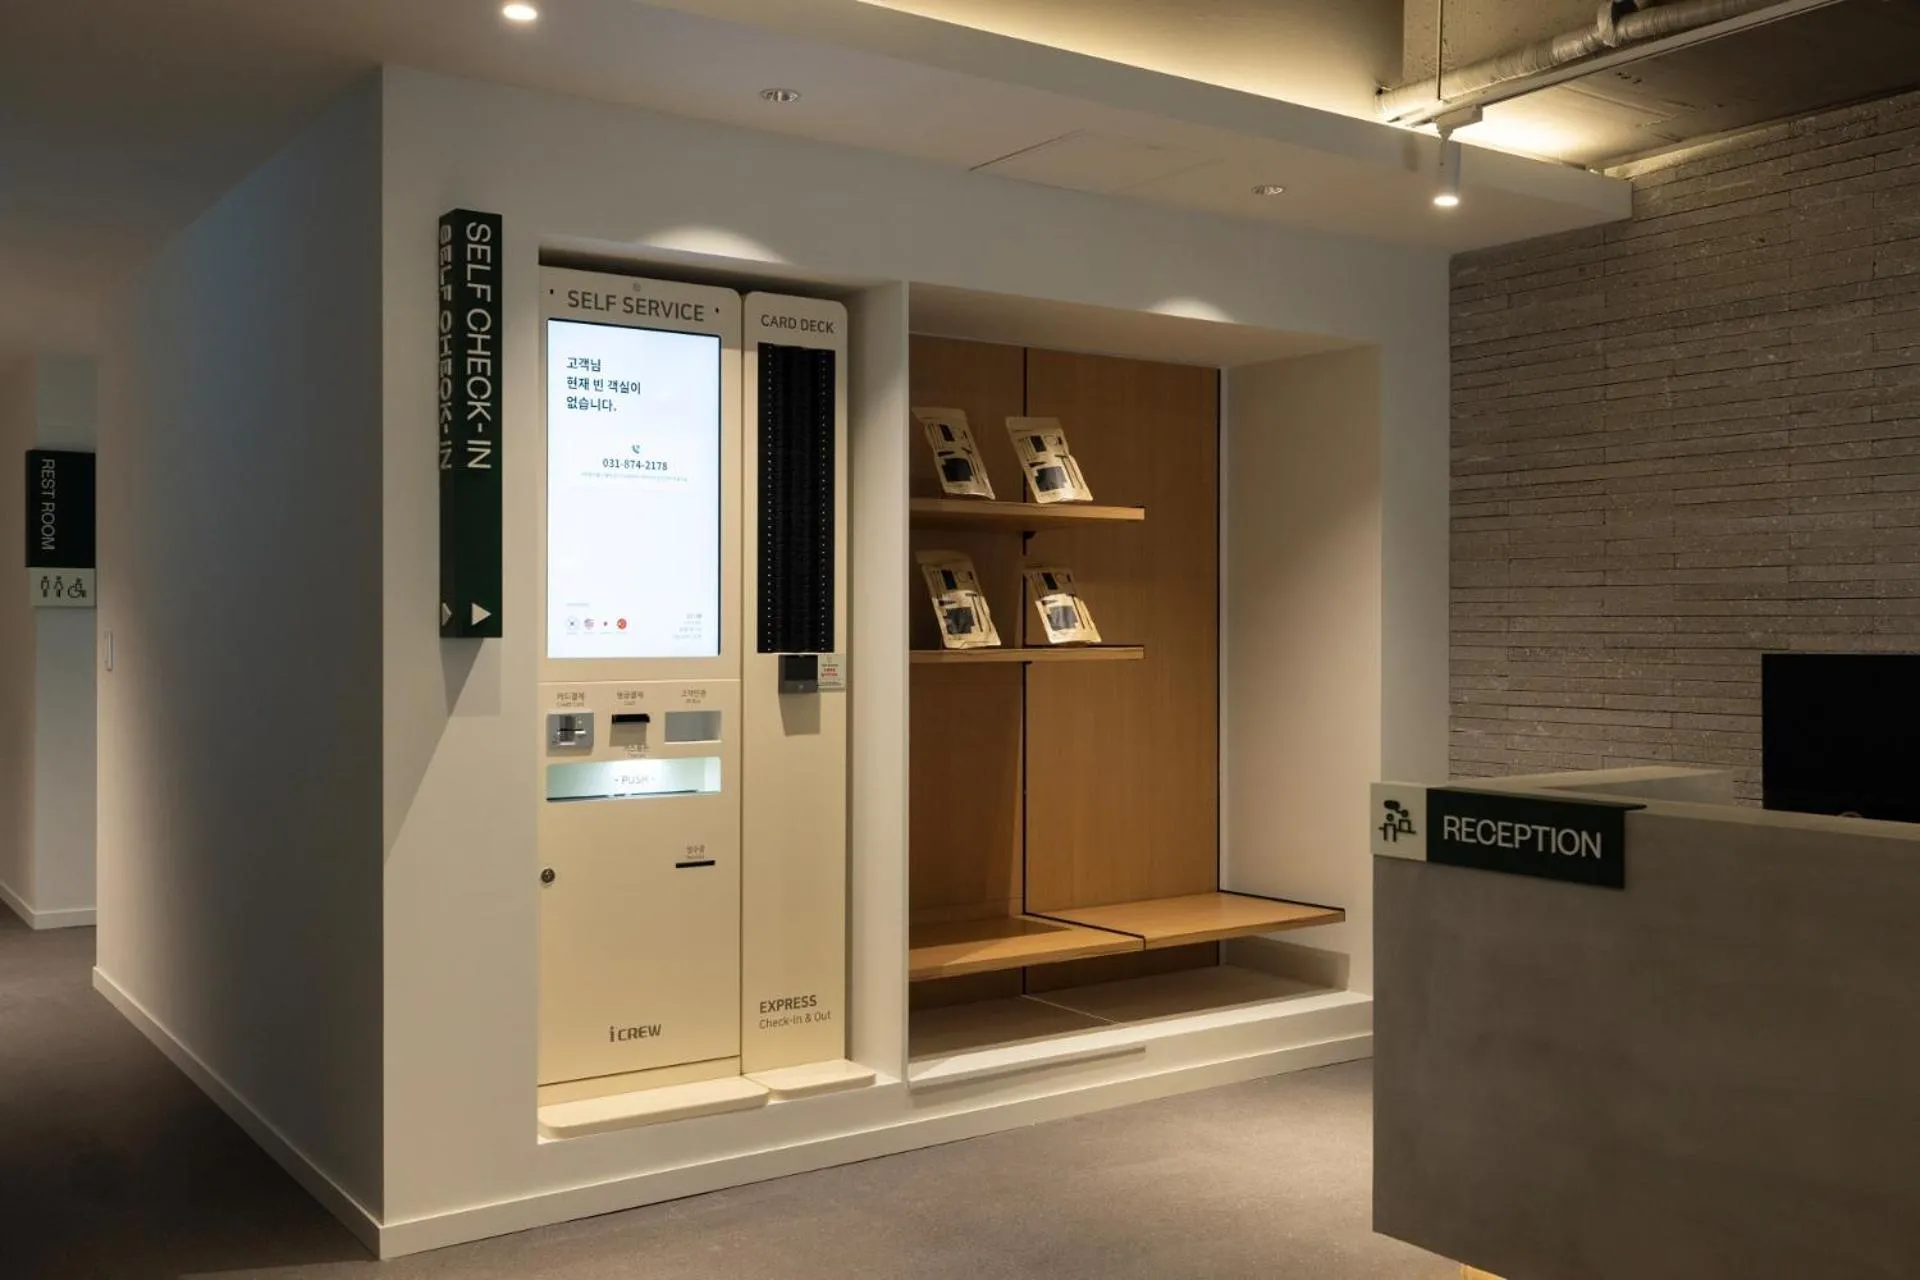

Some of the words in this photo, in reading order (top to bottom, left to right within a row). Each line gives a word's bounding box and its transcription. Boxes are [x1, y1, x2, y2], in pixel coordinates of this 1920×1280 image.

[439, 224, 452, 301] SELF
[466, 221, 491, 302] SELF
[568, 290, 617, 312] SELF
[622, 296, 705, 322] SERVICE
[761, 314, 797, 331] CARD
[801, 317, 835, 334] DECK
[566, 357, 601, 372] 고객님
[466, 309, 491, 470] CHECK-IN
[566, 376, 589, 391] 현재
[593, 378, 604, 392] 빈
[607, 380, 641, 395] 객실이
[566, 396, 617, 412] 없습니다.
[602, 458, 668, 471] 031-874-2178
[41, 458, 56, 499] REST
[41, 502, 56, 550] ROOM
[1443, 815, 1602, 859] RECEPTION
[759, 995, 817, 1014] EXPRESS
[804, 1013, 812, 1024] &
[814, 1010, 832, 1023] Out
